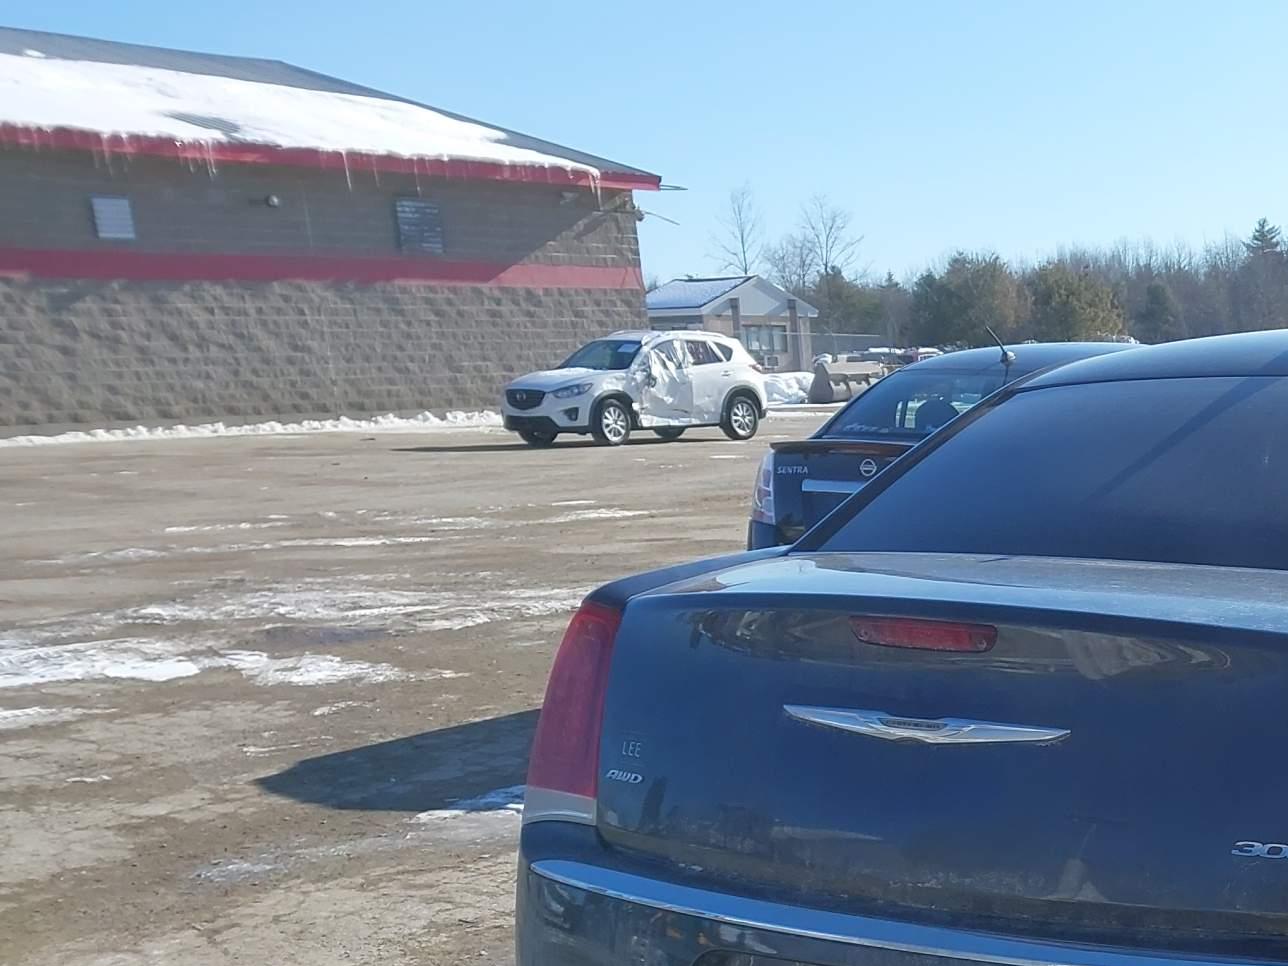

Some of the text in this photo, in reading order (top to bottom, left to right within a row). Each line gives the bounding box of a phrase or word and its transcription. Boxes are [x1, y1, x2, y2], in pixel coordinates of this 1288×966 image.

[776, 466, 809, 474] SENTRA
[622, 741, 641, 758] LEE
[605, 769, 643, 784] AWD
